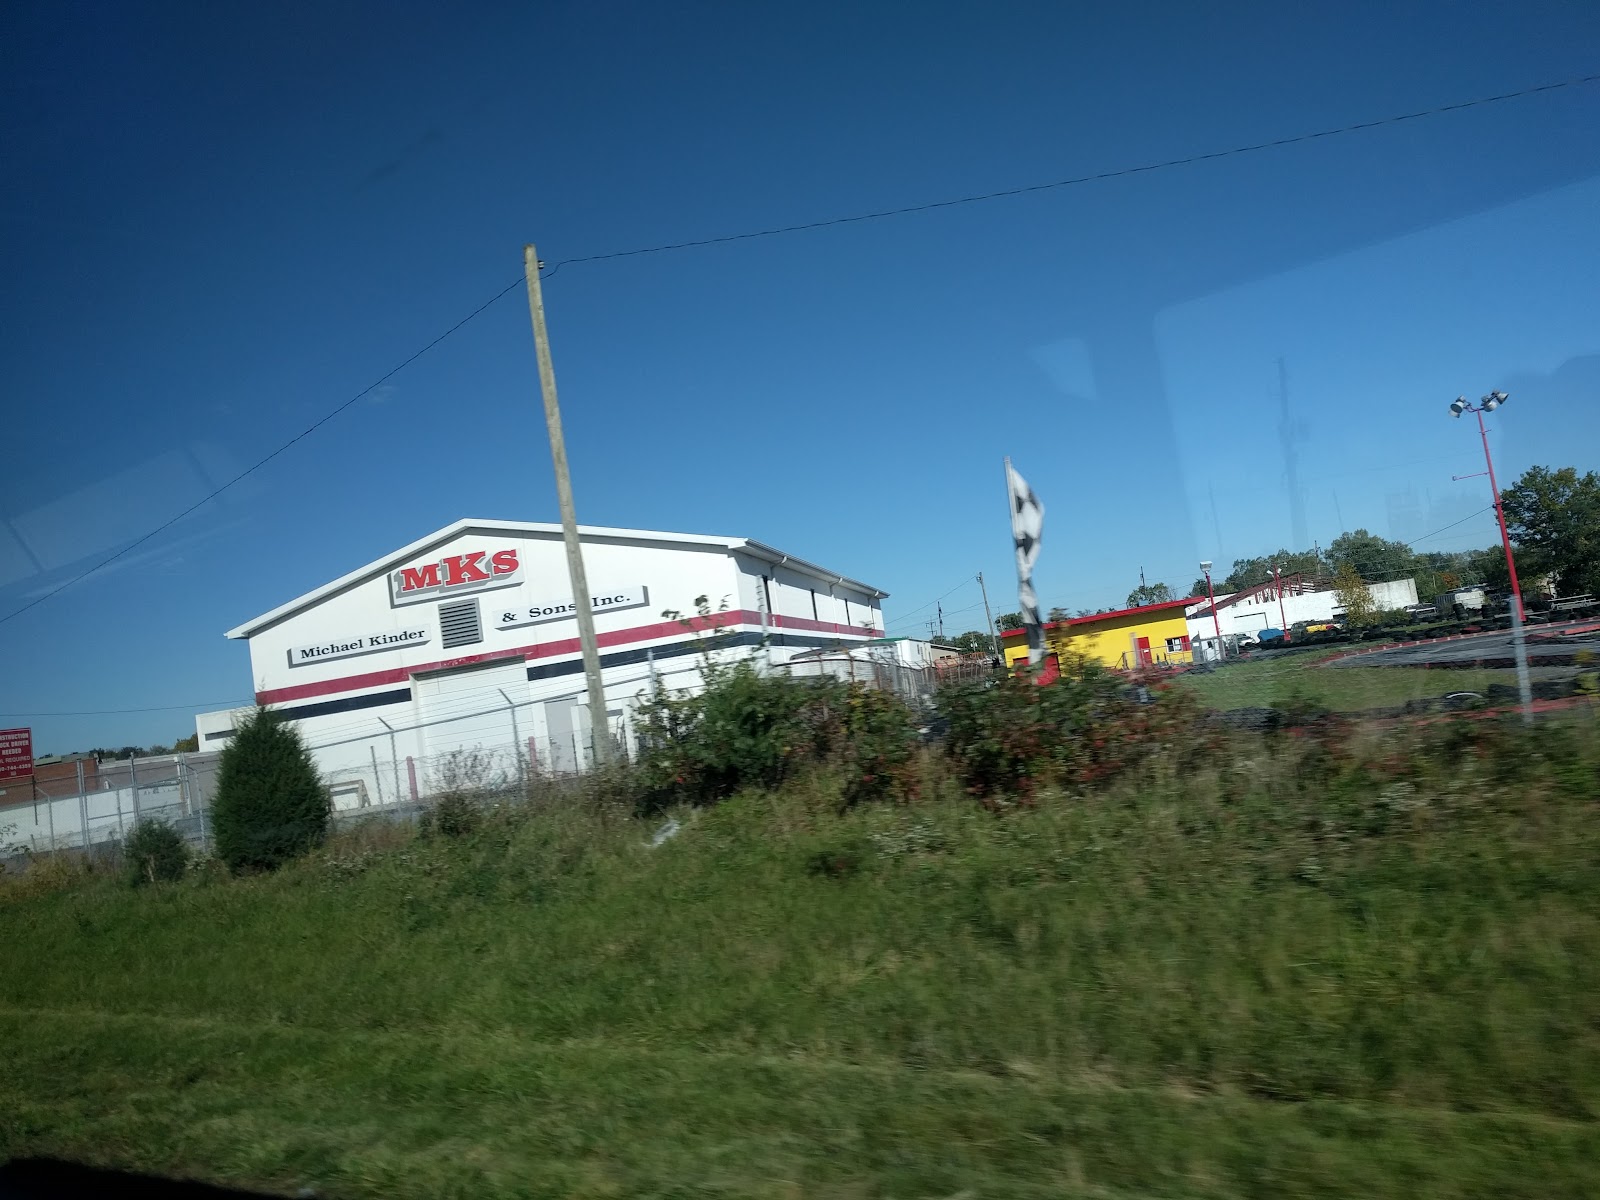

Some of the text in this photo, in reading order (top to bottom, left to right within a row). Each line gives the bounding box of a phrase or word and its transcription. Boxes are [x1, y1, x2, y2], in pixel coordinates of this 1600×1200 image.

[400, 548, 520, 592] MKS
[502, 612, 517, 622] &
[591, 594, 631, 607] Inc.
[300, 630, 425, 659] Michael Kinder
[5, 755, 30, 763] REQUIRED
